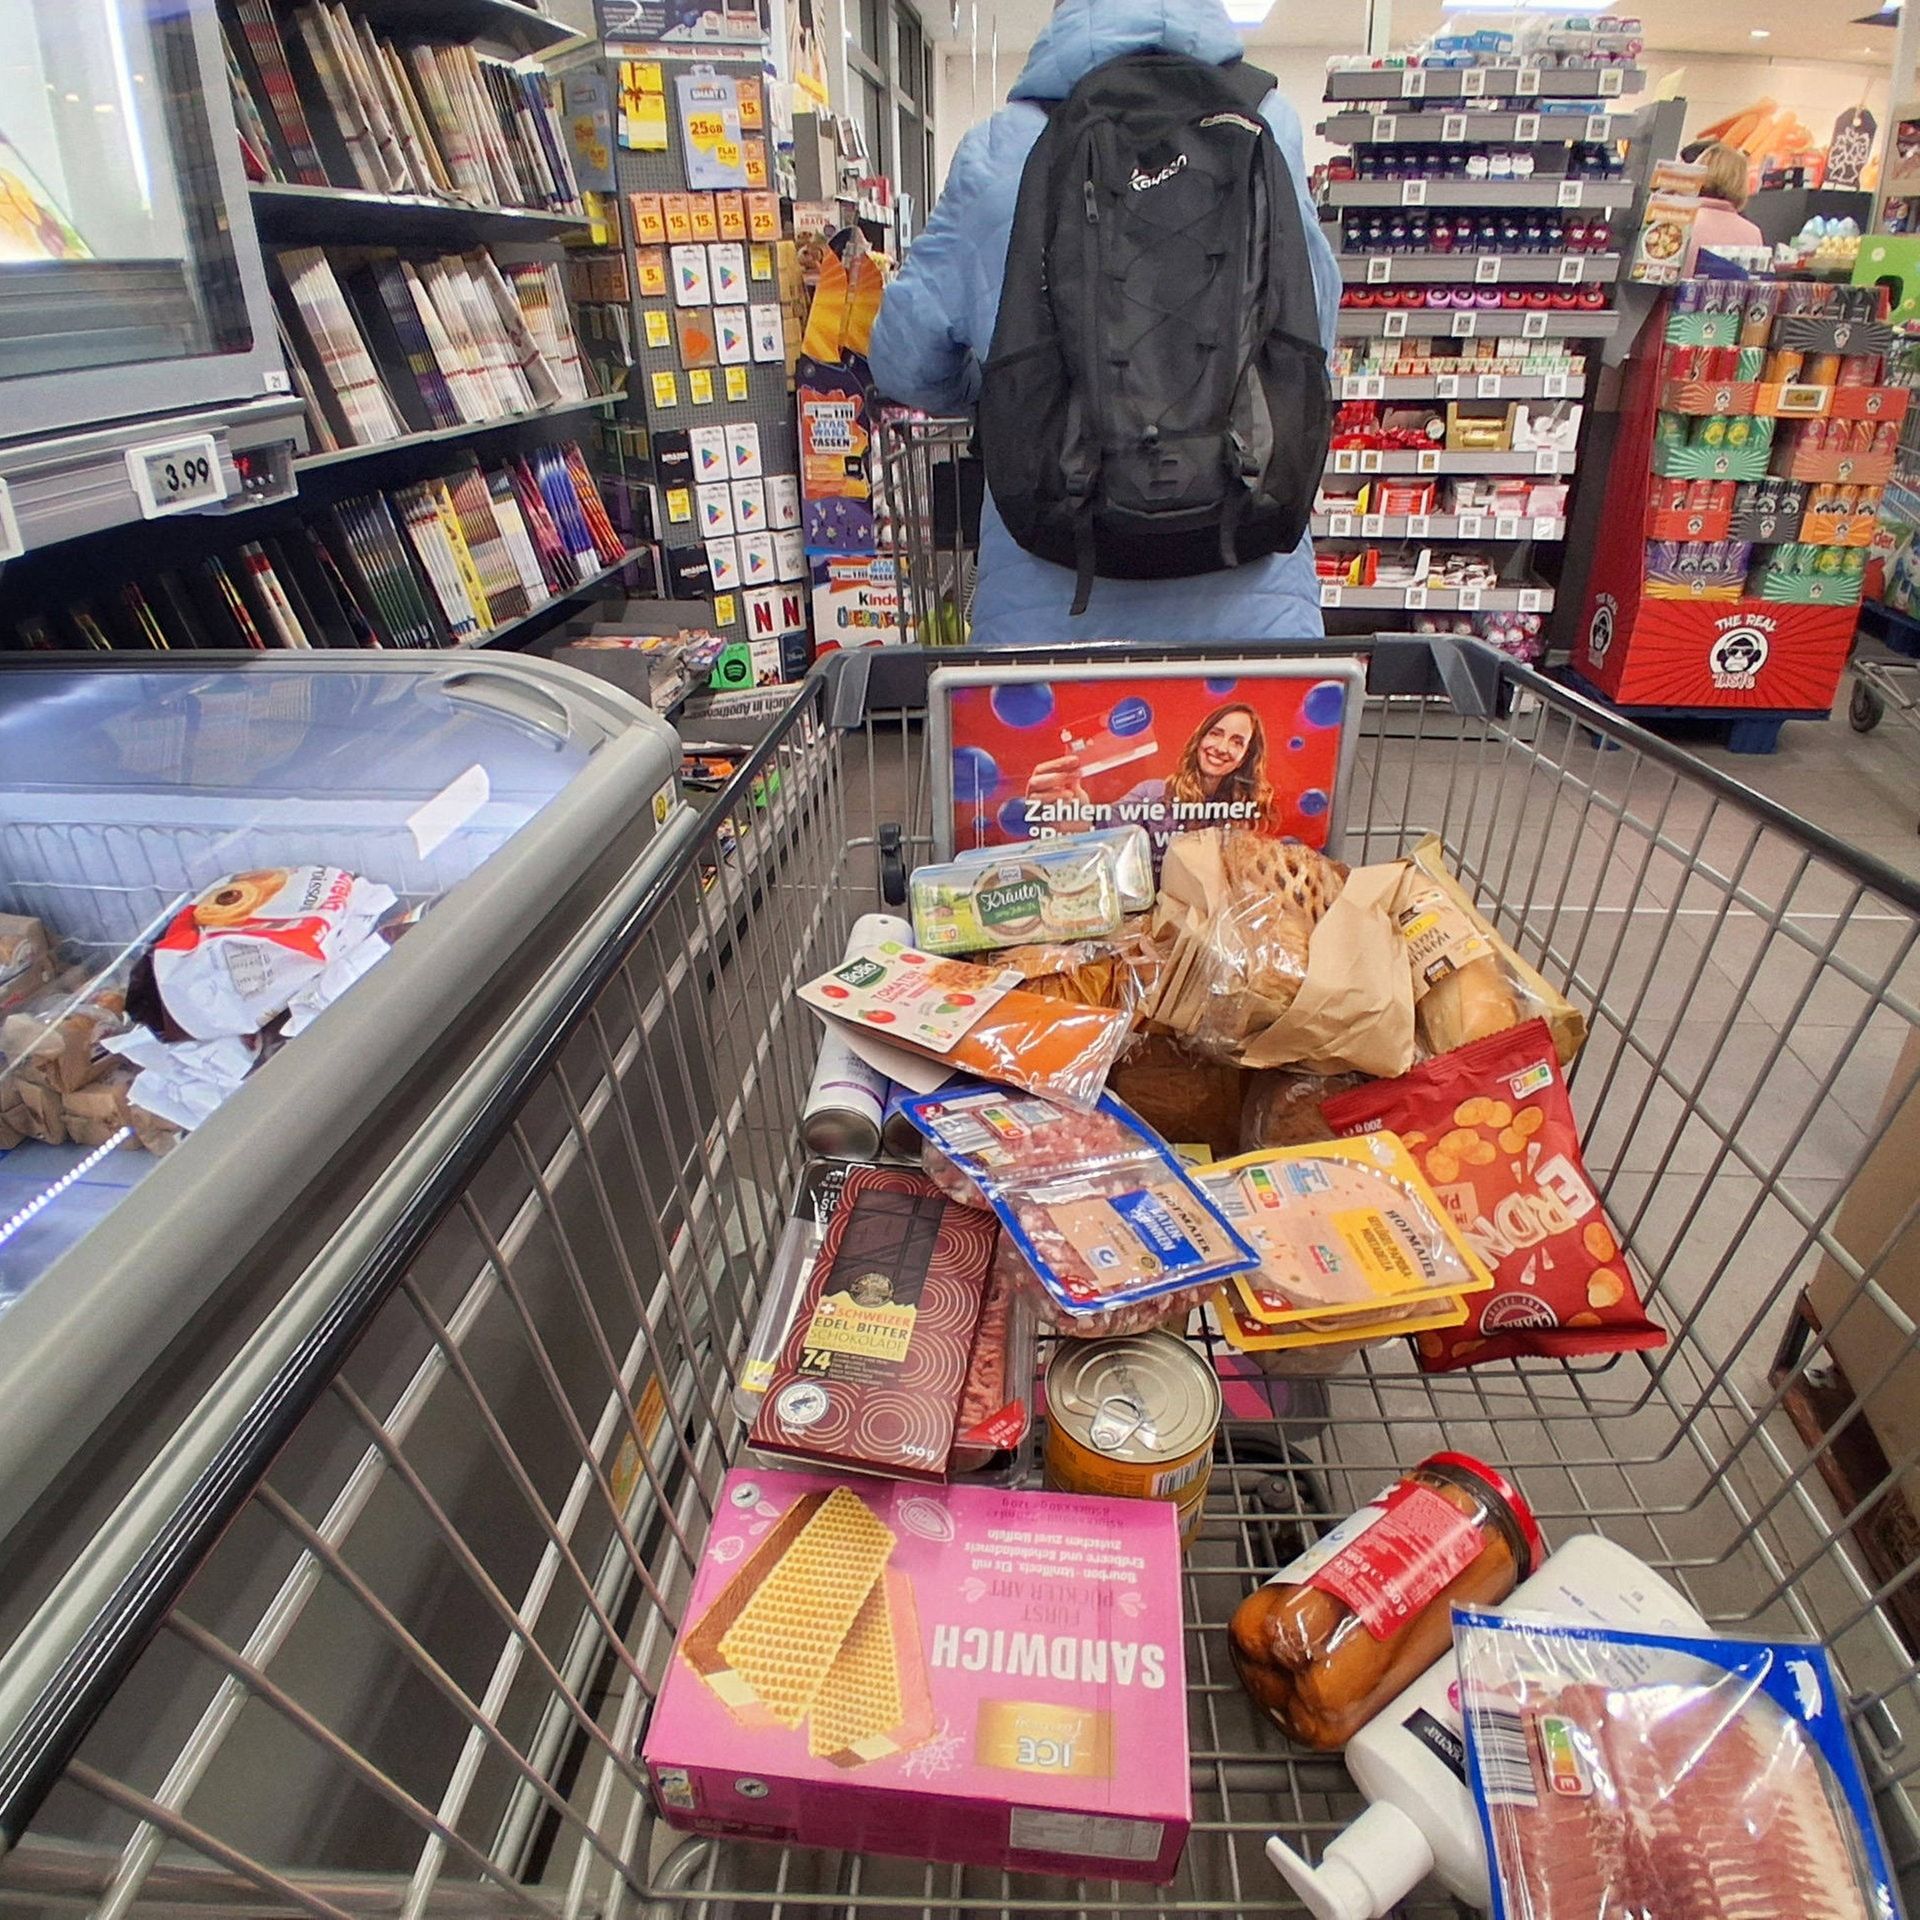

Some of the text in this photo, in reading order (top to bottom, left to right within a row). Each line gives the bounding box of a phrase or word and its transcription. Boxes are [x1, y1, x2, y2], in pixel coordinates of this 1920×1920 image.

[812, 438, 850, 447] TASSEN
[165, 457, 209, 492] 3.99
[859, 590, 905, 606] Kinde
[754, 601, 773, 633] N
[783, 596, 801, 627] N
[1714, 613, 1779, 633] THE REAL
[1024, 797, 1262, 823] Zahlen wie immer.
[979, 881, 1046, 913] Kräuter
[1363, 1118, 1383, 1132] 200
[1156, 1191, 1211, 1253] HOFMAIER
[1462, 1153, 1596, 1271] ERDN
[1385, 1209, 1437, 1279] HOFMAIER
[838, 1307, 911, 1327] SCHWEIZER
[810, 1327, 907, 1352] SCHOKOLADE
[802, 1348, 832, 1370] 74
[1033, 1533, 1062, 1545] zwei
[1065, 1536, 1122, 1550] zwischen
[964, 1541, 1145, 1569] Erdbeere und Schokoladeneis
[994, 1559, 1013, 1573] Eis
[990, 1579, 1114, 1608] PÜCKLER ART
[1024, 1604, 1081, 1628] FÜRST
[929, 1624, 1166, 1688] SANDWICH
[1016, 1735, 1071, 1768] ICE
